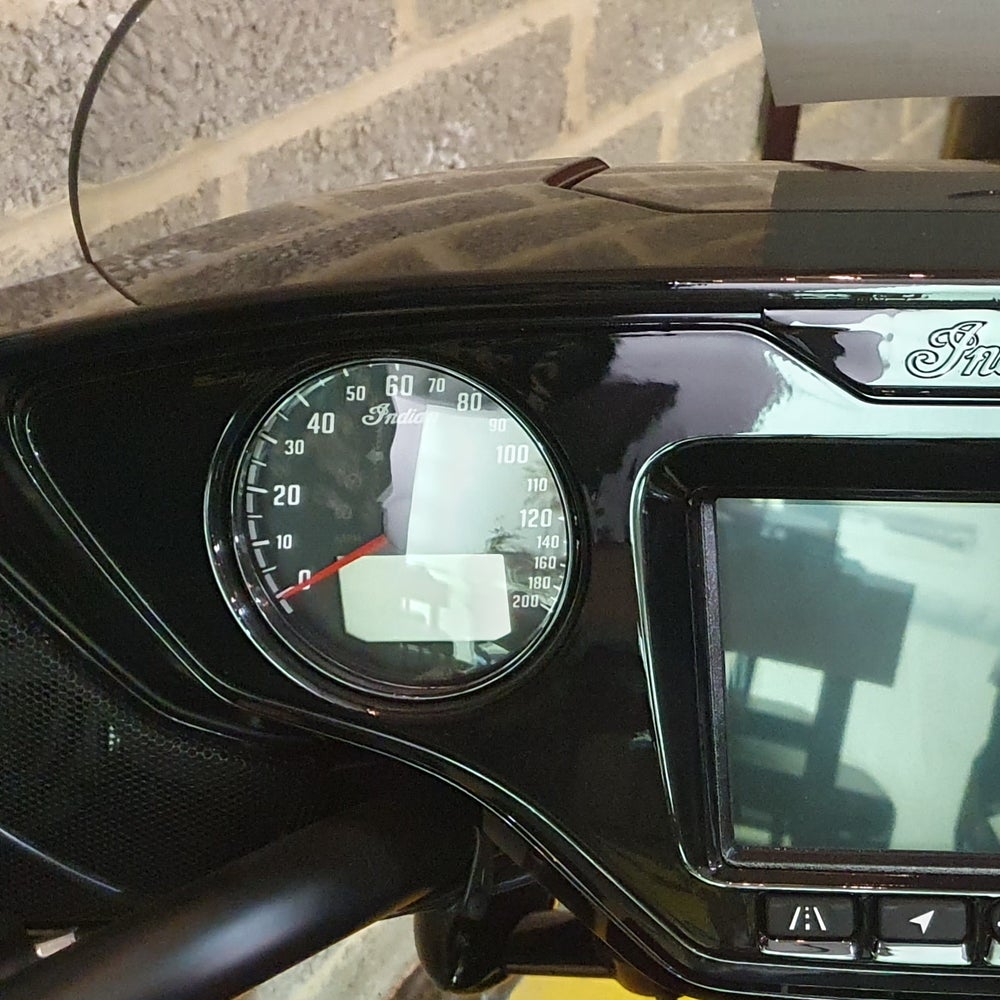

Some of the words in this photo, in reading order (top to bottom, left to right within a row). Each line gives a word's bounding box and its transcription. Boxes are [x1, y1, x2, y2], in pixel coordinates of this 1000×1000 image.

[385, 375, 414, 397] 60
[428, 378, 446, 393] 70
[346, 386, 365, 401] 50
[457, 392, 482, 412] 80
[361, 403, 435, 426] India
[307, 412, 335, 434] 40
[489, 417, 507, 432] 90
[284, 440, 304, 455] 30
[496, 444, 529, 464] 100
[527, 478, 548, 493] 110
[273, 484, 300, 506] 20
[520, 508, 552, 528] 120
[276, 534, 293, 550] 10
[536, 535, 560, 549] 140
[534, 556, 557, 570] 160
[298, 569, 311, 590] 0
[528, 576, 551, 590] 180
[512, 594, 539, 608] 200
